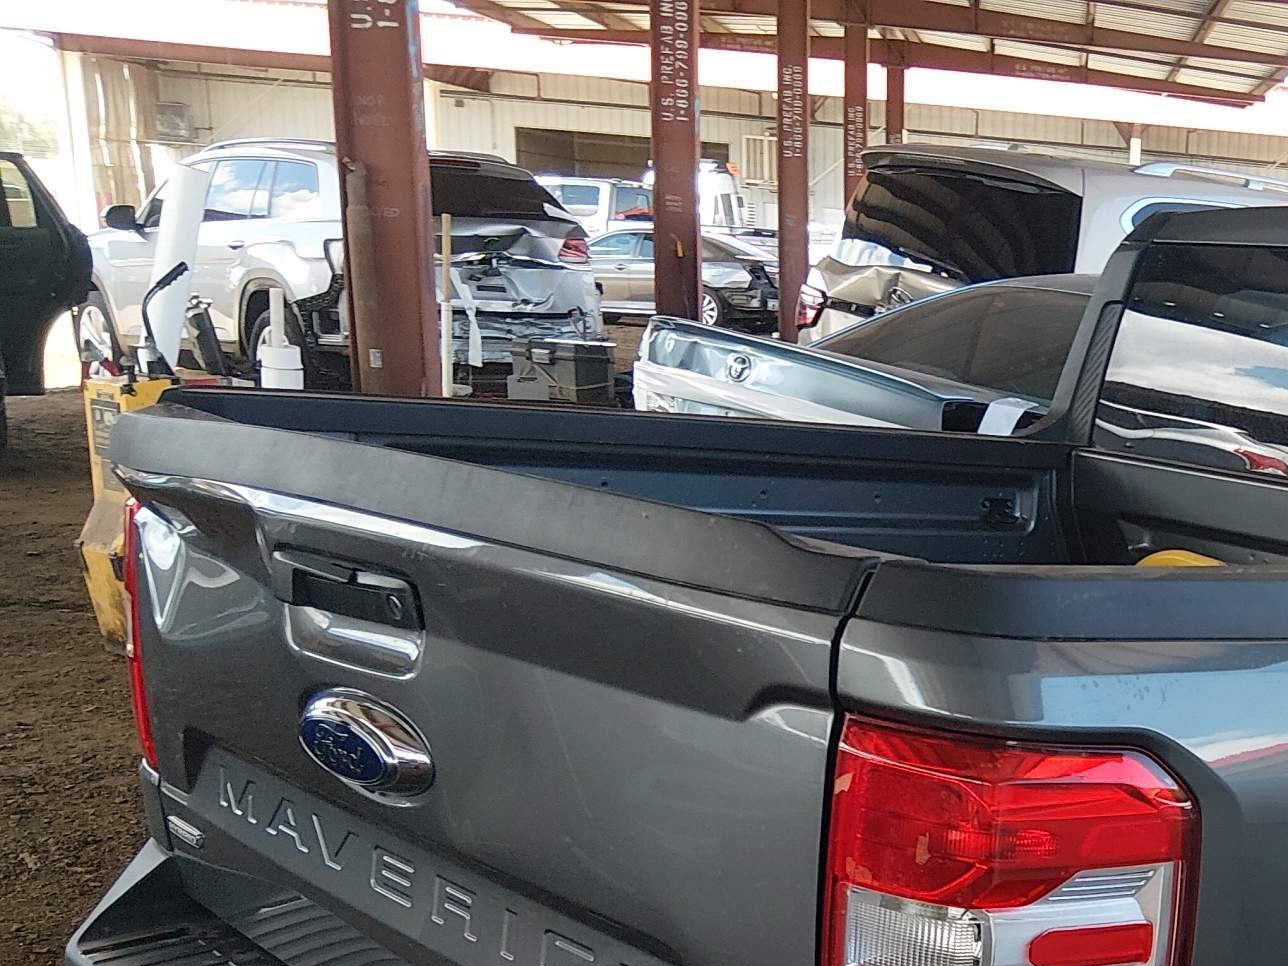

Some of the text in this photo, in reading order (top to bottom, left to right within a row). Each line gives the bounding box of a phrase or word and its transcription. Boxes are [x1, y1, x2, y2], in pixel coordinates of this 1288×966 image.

[350, 0, 373, 29] U.
[376, 0, 399, 28] 1-
[659, 0, 674, 17] IN
